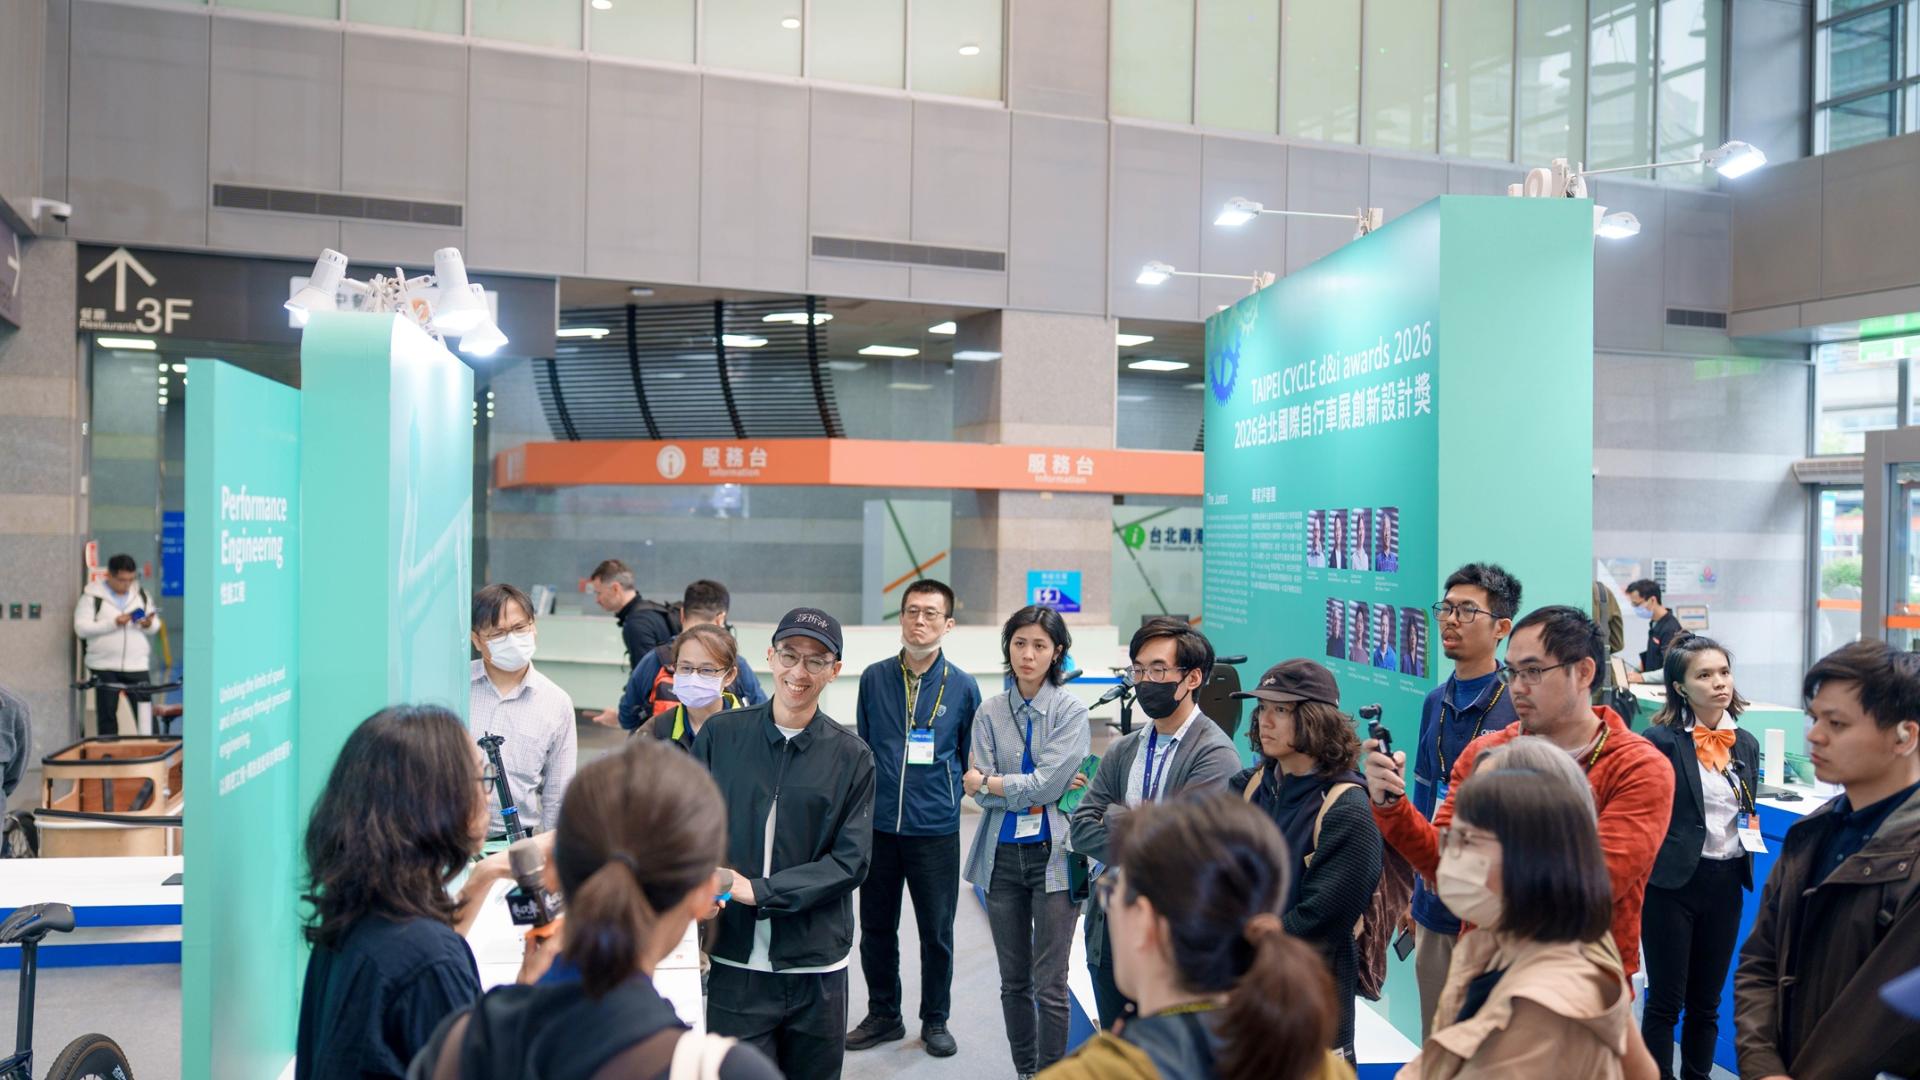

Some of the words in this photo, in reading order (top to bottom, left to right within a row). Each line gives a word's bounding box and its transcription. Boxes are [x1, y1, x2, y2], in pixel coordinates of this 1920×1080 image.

[79, 319, 138, 332] Restaurants
[136, 297, 193, 334] 3F
[1251, 371, 1281, 406] TAIPEI
[1283, 360, 1316, 396] CYCLE
[1319, 351, 1340, 386] d&i
[1344, 336, 1390, 378] awards
[1394, 321, 1432, 365] 2026
[1234, 372, 1431, 449] 2026台北國際自行車展創新設計獎
[702, 446, 768, 468] 服務台
[1028, 453, 1094, 476] 服務台
[1035, 474, 1087, 484] Information
[221, 484, 287, 521] Performance
[221, 527, 284, 573] Engineering
